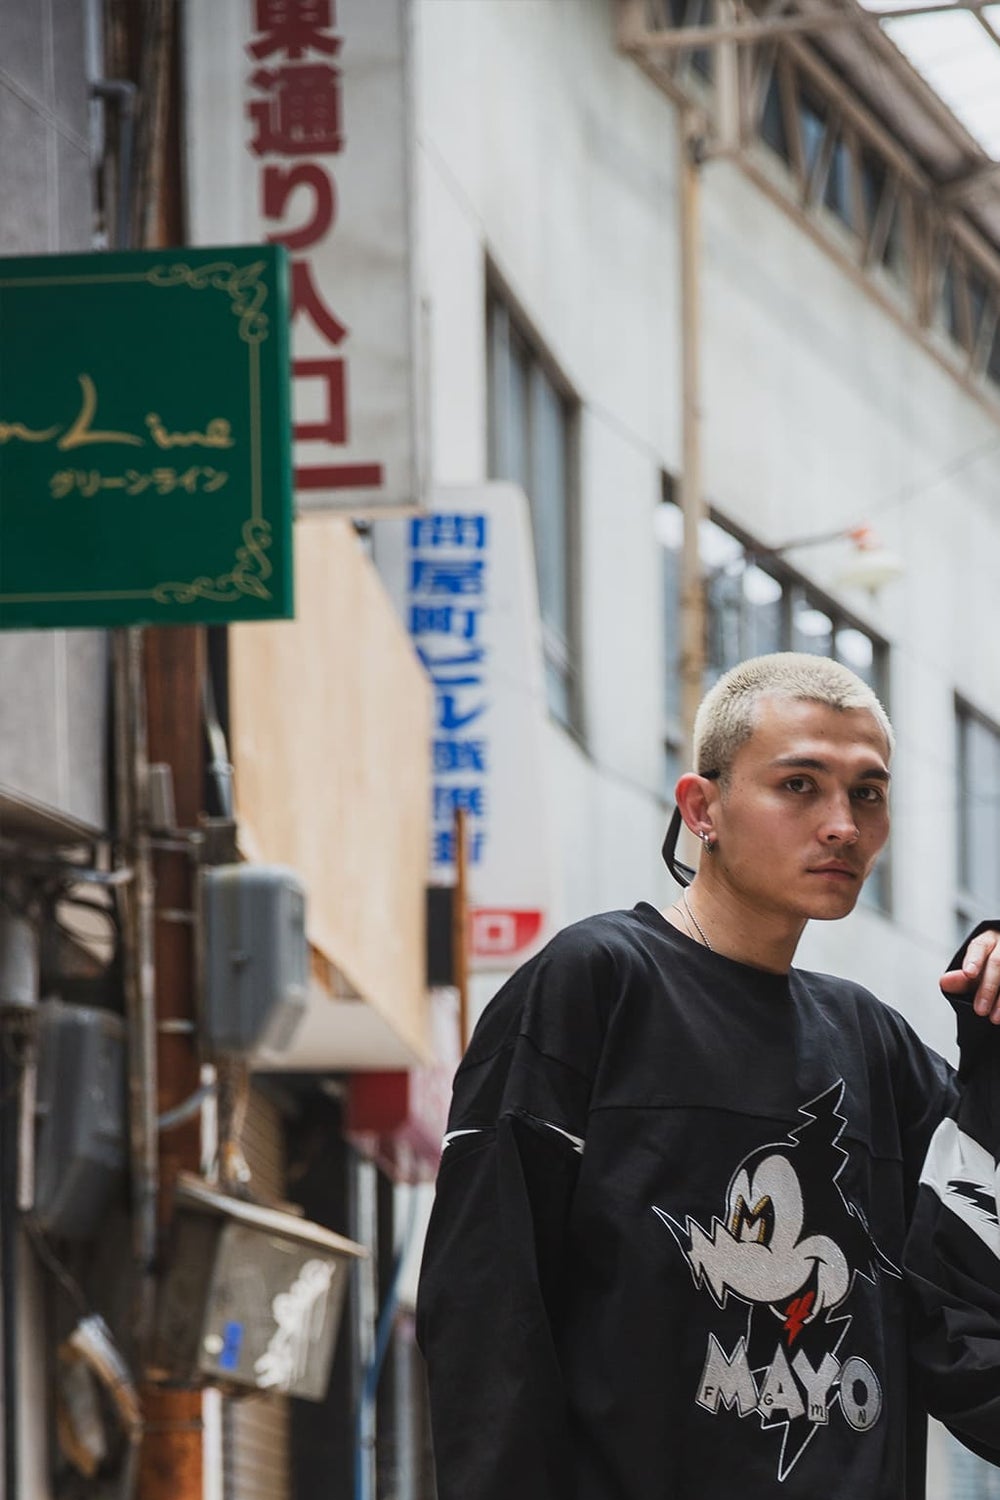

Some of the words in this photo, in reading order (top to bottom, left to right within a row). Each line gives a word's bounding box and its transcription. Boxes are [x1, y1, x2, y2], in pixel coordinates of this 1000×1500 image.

[50, 465, 229, 499] グリーンライン
[696, 1332, 883, 1432] MAYO
